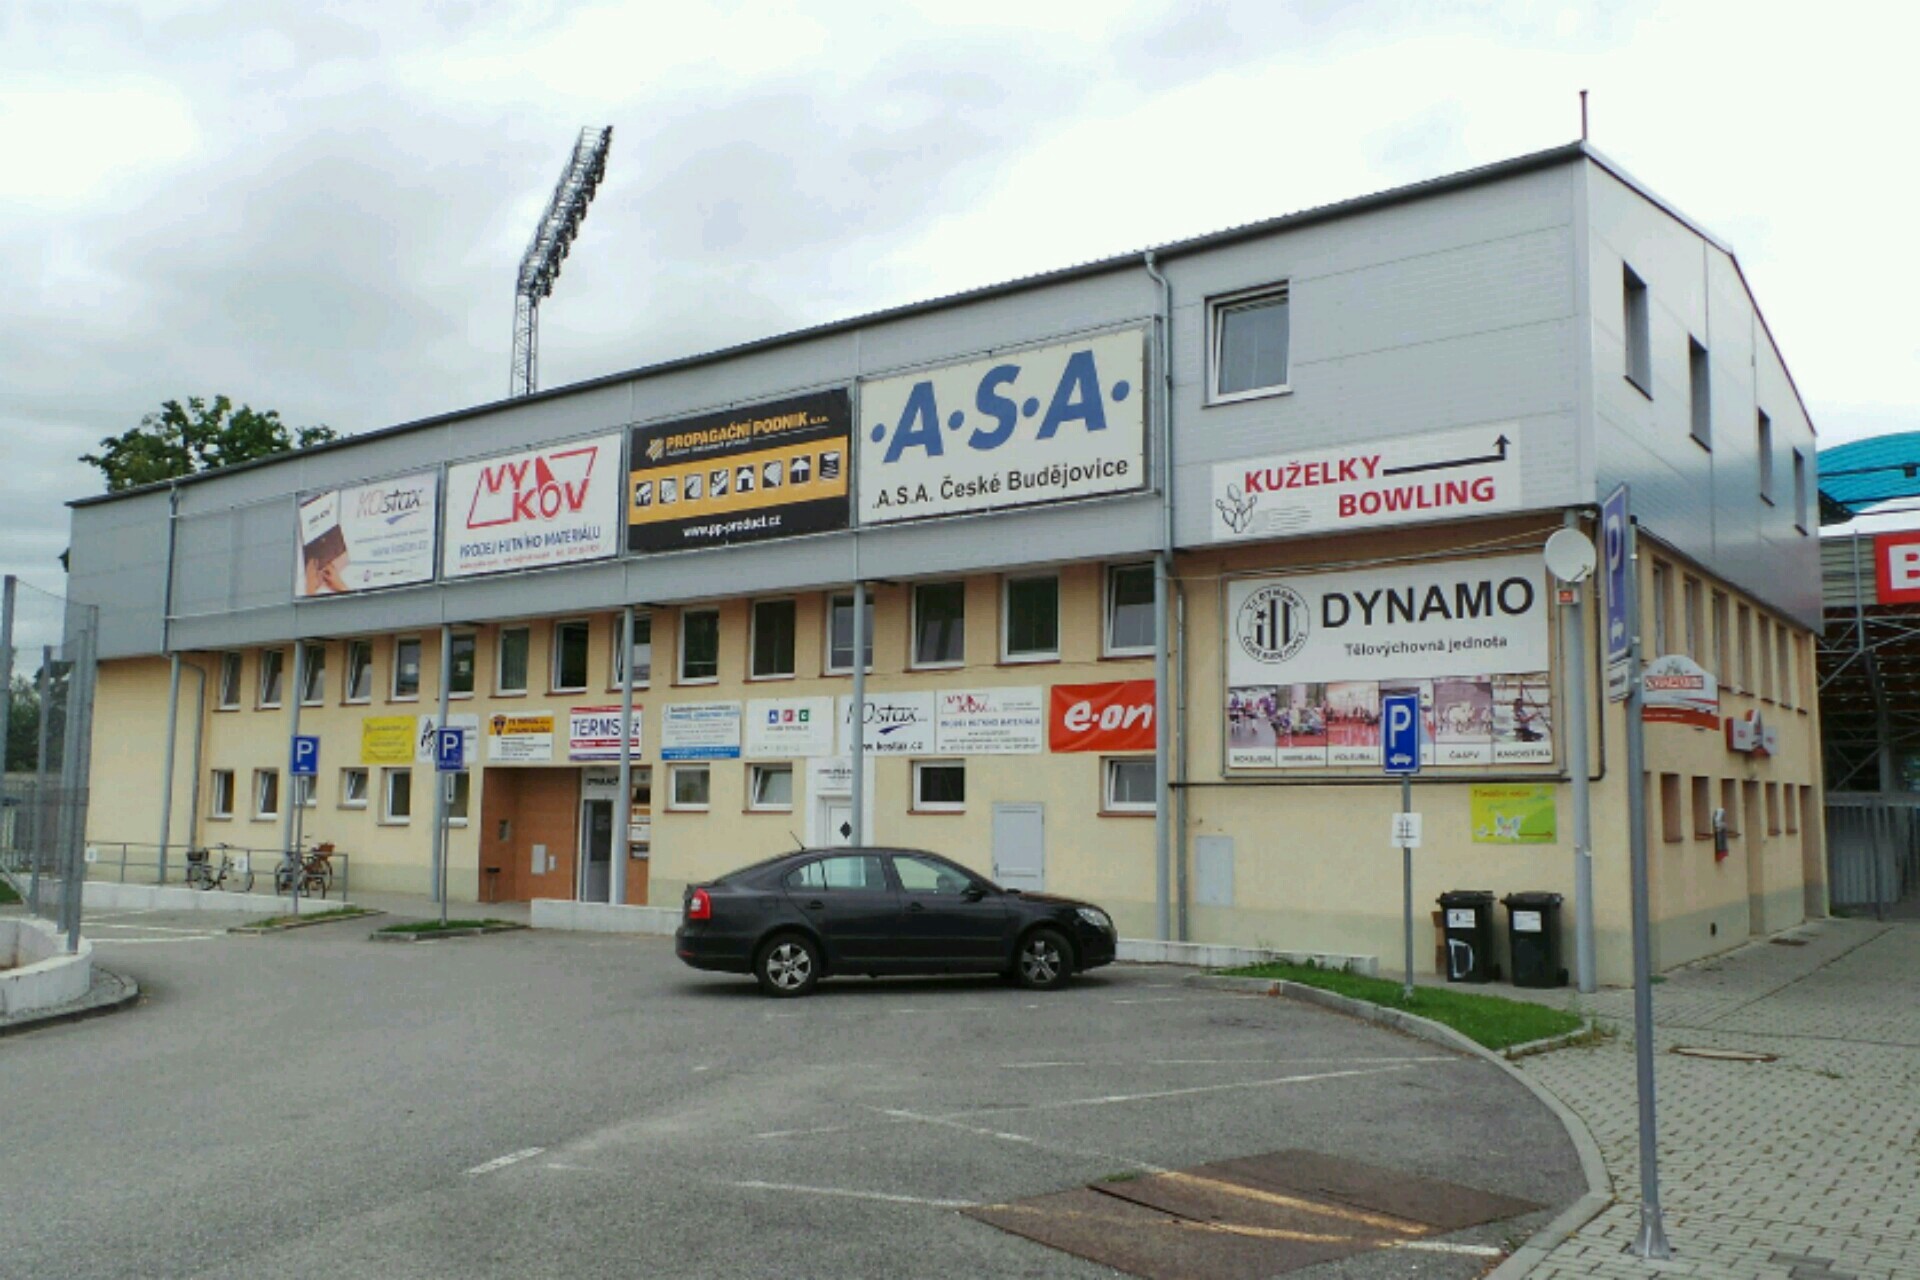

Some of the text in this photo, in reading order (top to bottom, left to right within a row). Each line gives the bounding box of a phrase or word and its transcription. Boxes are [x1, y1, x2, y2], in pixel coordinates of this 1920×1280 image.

[666, 419, 750, 449] PROPAGAČNÍ
[753, 411, 808, 436] PODNIK
[941, 476, 1000, 500] České
[1007, 458, 1129, 491] Budějovice
[1245, 455, 1381, 494] KUŽELKY
[1338, 476, 1495, 518] BOWLING
[544, 524, 600, 545] MATERIÁLU
[682, 515, 781, 537] www.pp-product.cz
[1608, 514, 1619, 607] P
[1322, 577, 1535, 628] DYNAMO
[1344, 635, 1508, 658] Tělovýchovná jednota
[572, 718, 620, 736] TERMS
[1391, 705, 1411, 748] P
[297, 741, 313, 763] P
[443, 734, 458, 758] P
